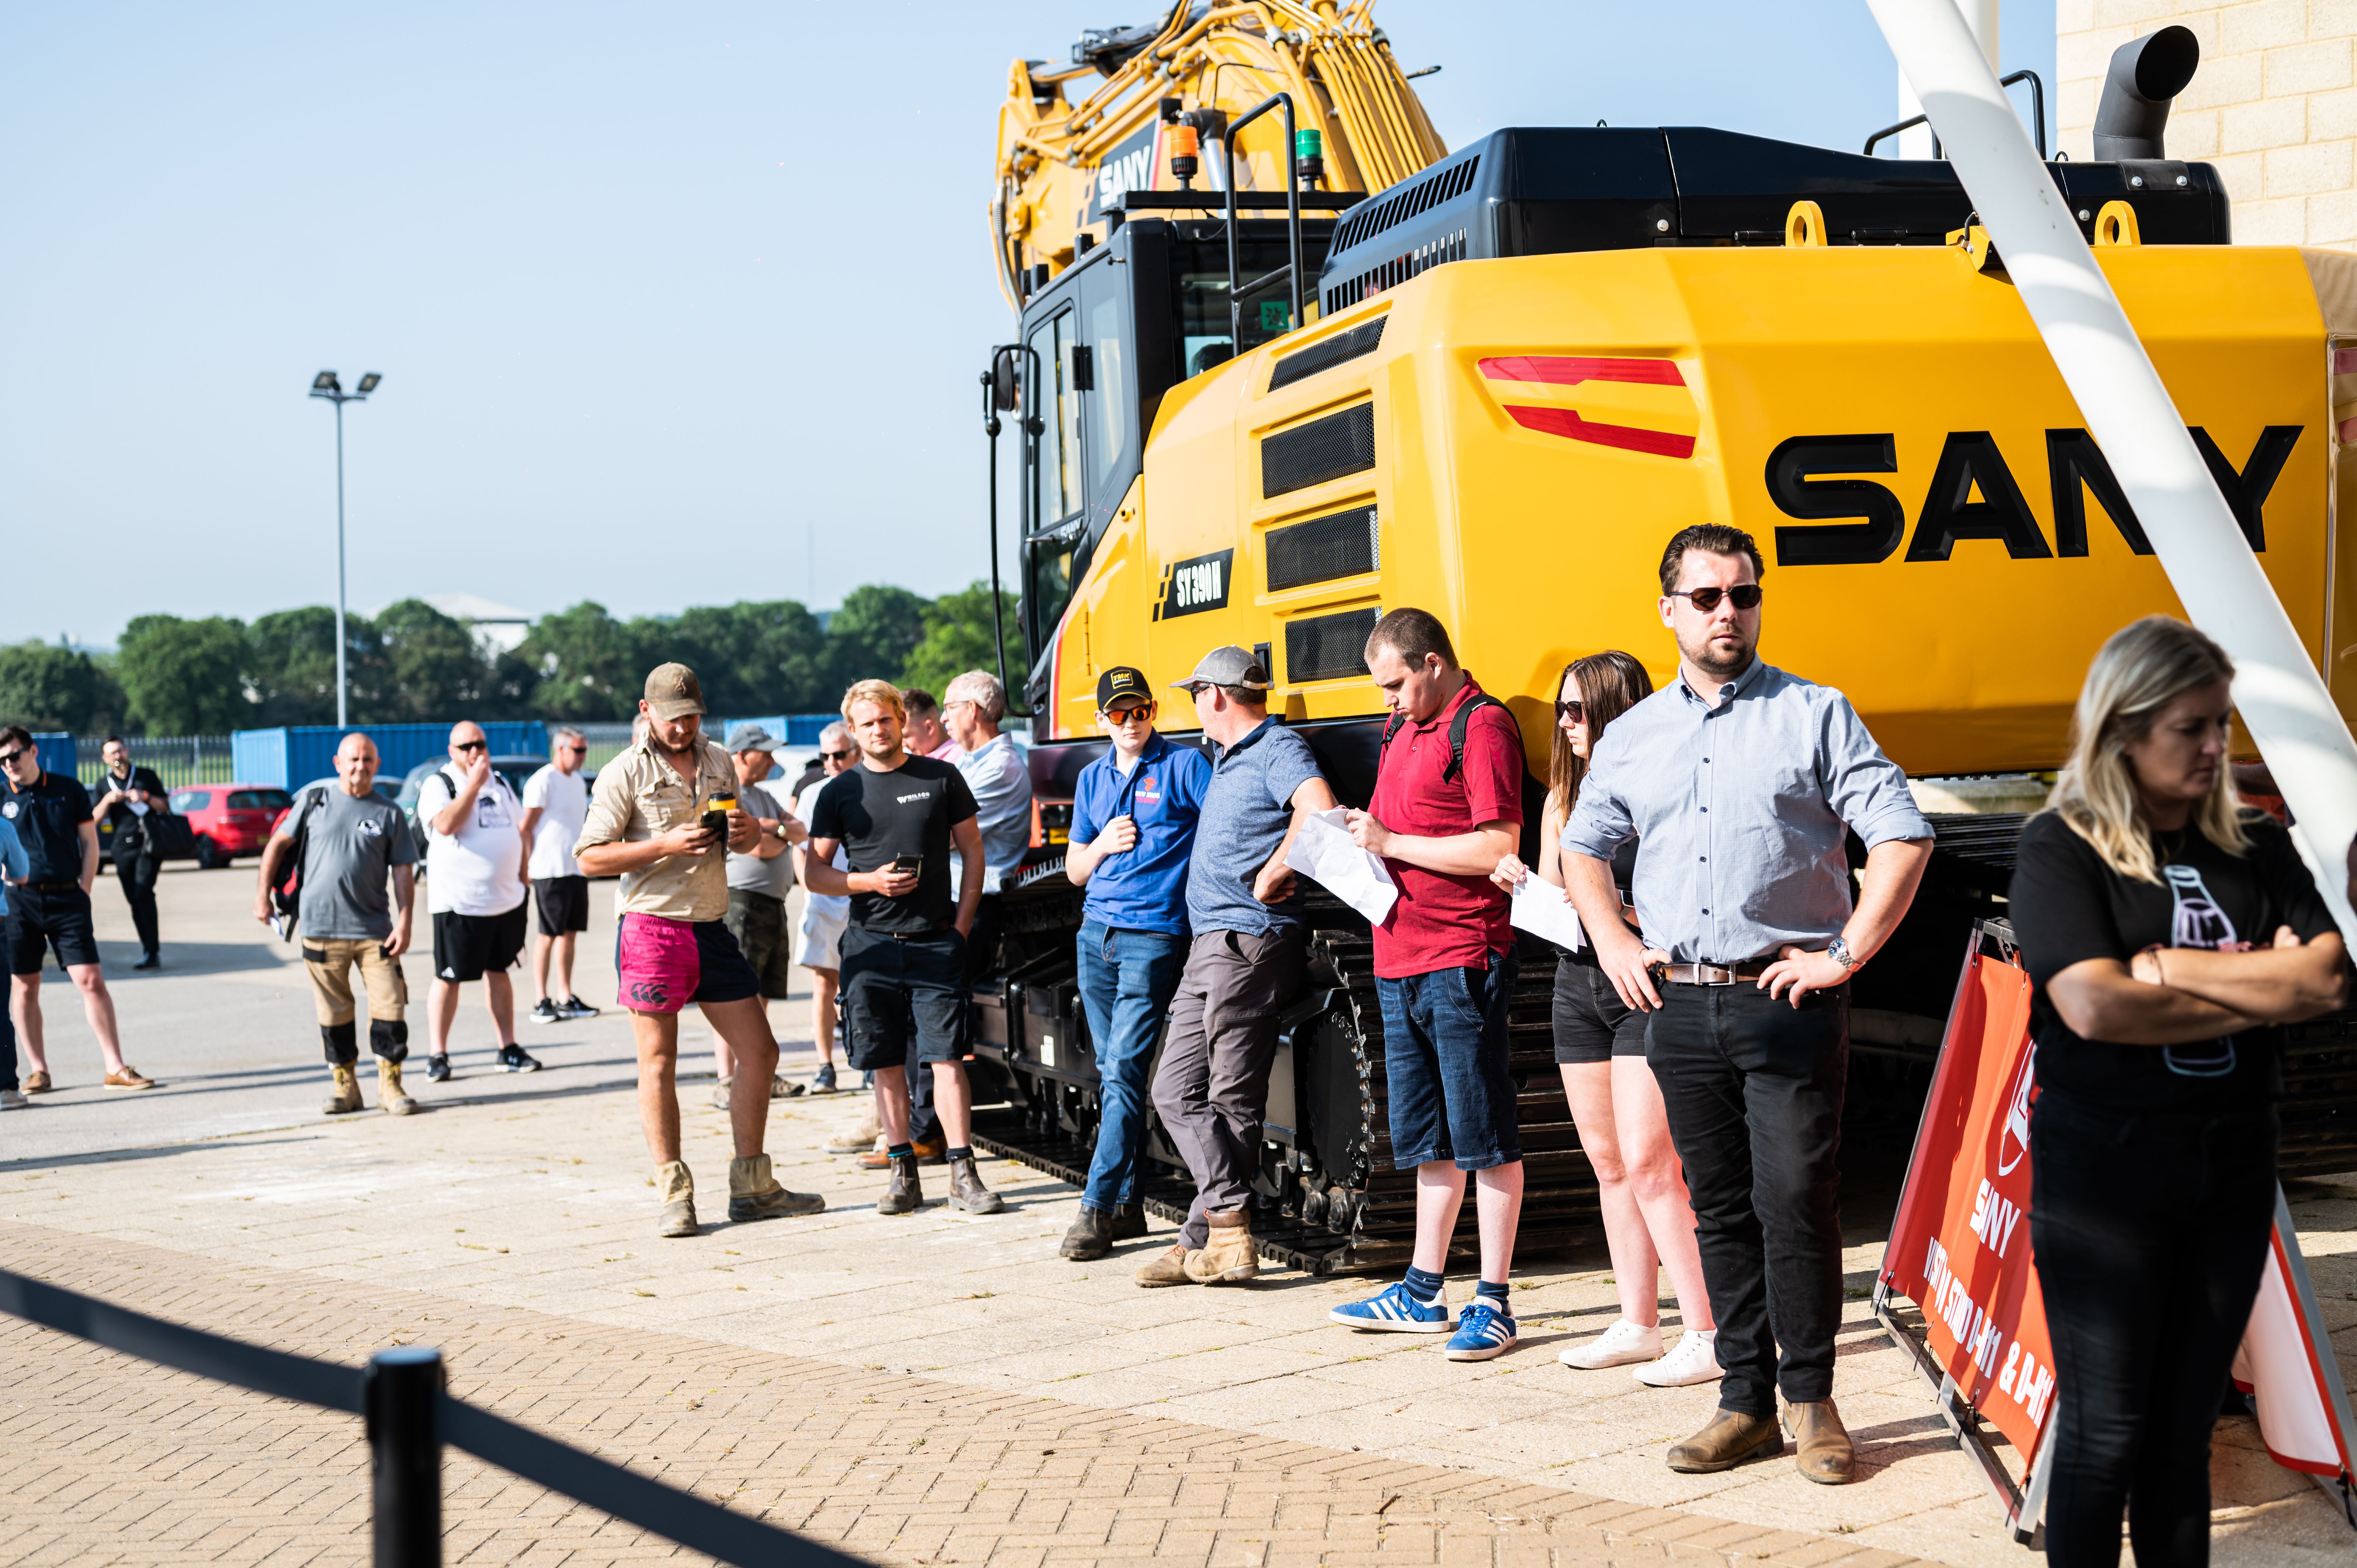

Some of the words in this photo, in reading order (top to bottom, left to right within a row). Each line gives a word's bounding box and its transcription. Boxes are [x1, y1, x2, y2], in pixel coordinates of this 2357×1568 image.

[1099, 145, 1150, 209] SANY
[1764, 425, 2305, 566] SANY
[1176, 560, 1222, 607] SY390H
[1113, 673, 1130, 681] TMK
[1969, 1178, 2021, 1259] SANY
[1966, 1306, 2002, 1379] D-H11
[1999, 1341, 2021, 1395] &
